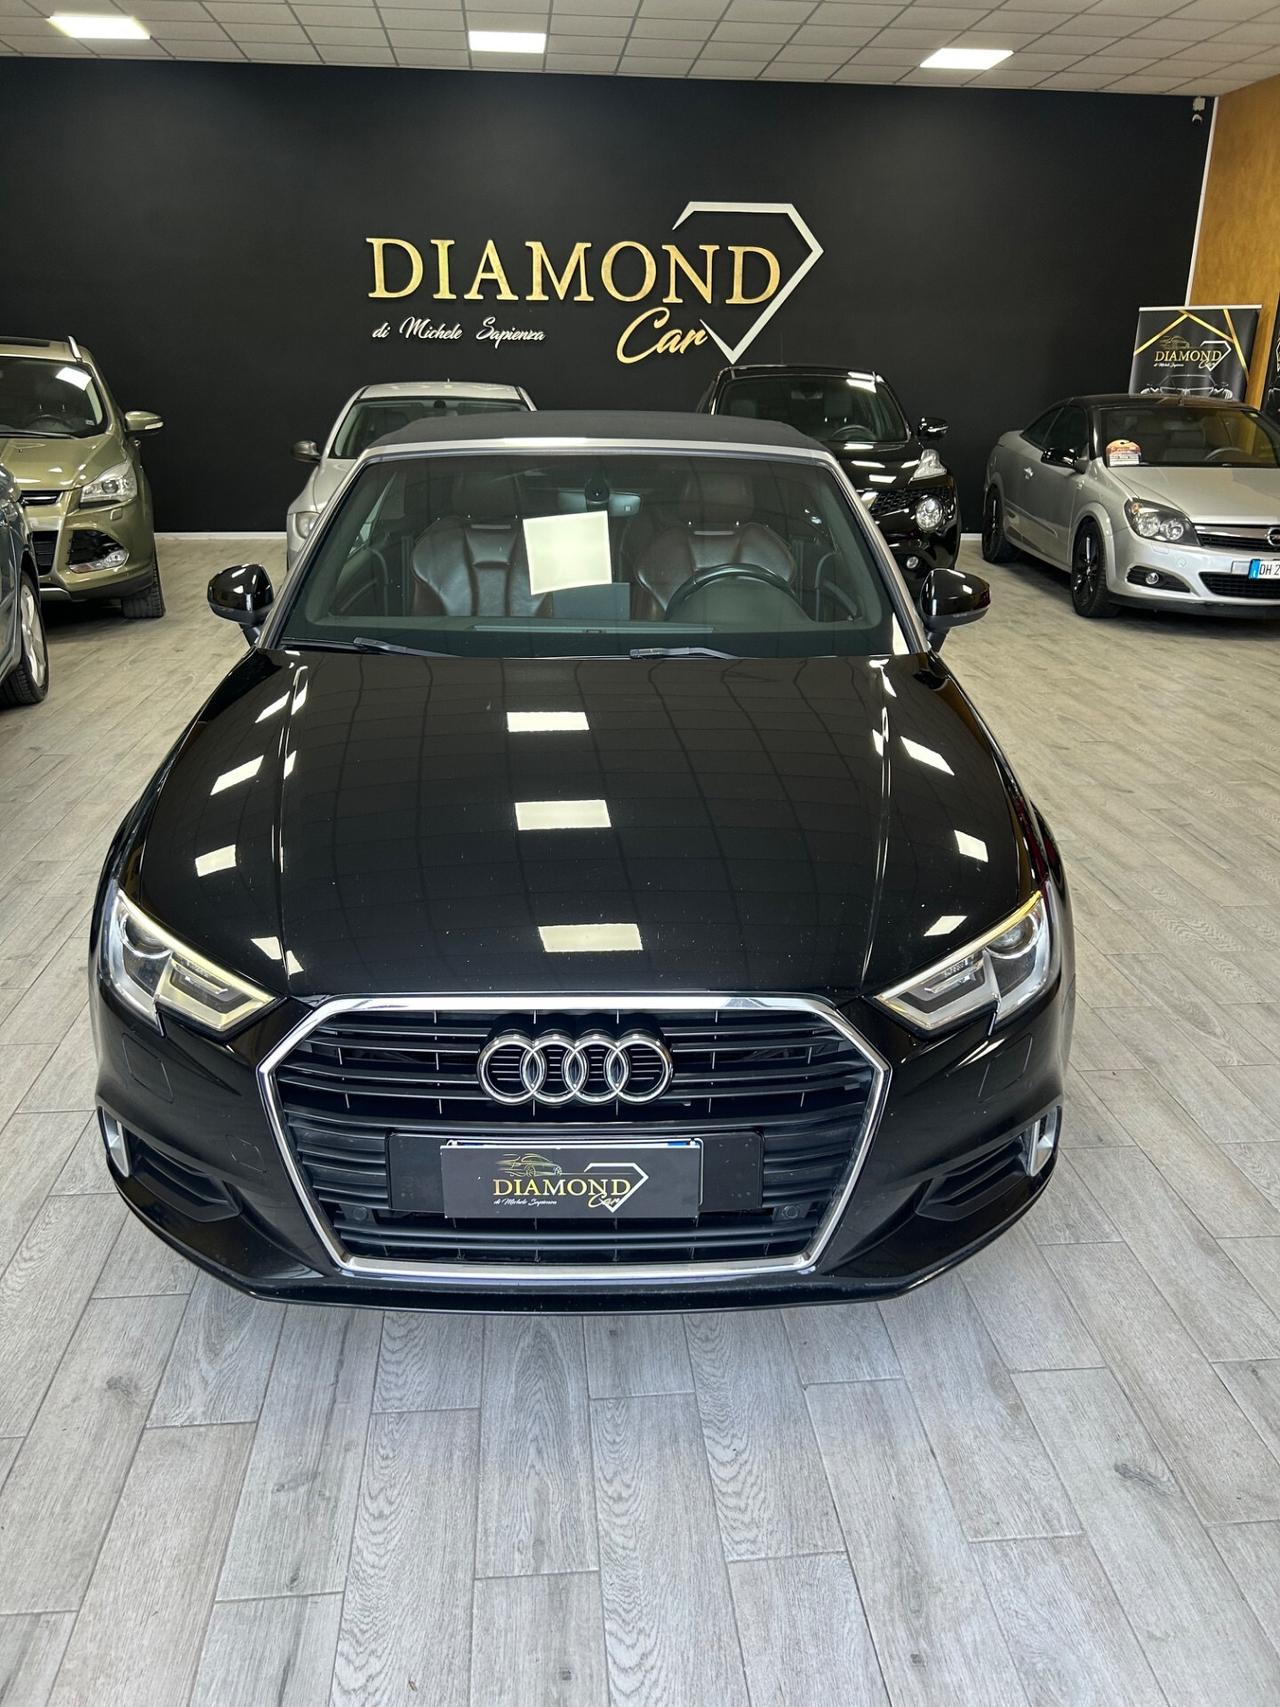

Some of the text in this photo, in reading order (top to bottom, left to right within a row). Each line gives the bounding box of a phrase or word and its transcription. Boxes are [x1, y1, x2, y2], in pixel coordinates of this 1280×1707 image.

[366, 237, 781, 305] DIAMOND
[372, 316, 546, 349] di Michele Sapienza
[616, 306, 708, 364] Car
[1154, 350, 1222, 362] DIAMOND
[492, 1178, 631, 1196] DIAMOND
[587, 1192, 621, 1208] Car
